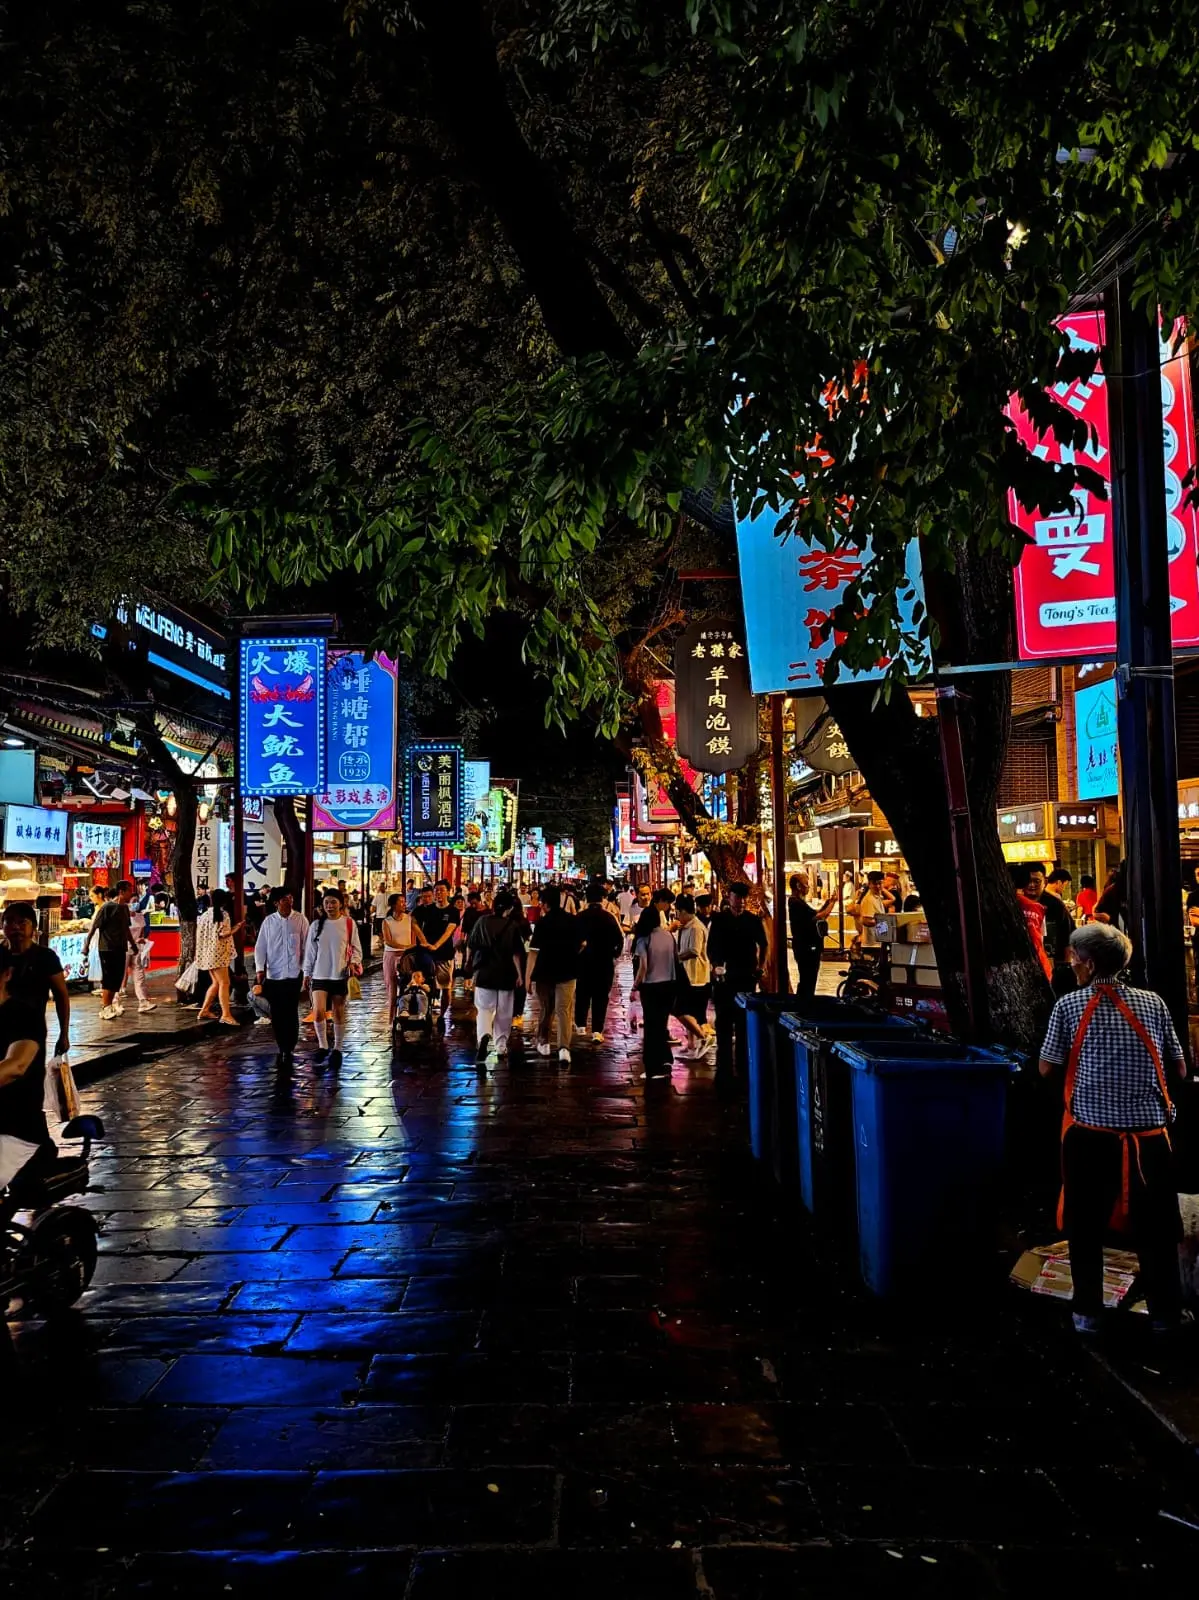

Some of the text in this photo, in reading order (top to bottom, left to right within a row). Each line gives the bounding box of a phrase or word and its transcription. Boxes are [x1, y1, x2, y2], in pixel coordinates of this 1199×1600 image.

[1044, 605, 1084, 622] Tong's
[1087, 604, 1109, 617] Tea
[249, 651, 316, 676] 火爆
[260, 703, 304, 788] 大鱿鱼
[342, 756, 368, 765] 传承
[343, 767, 367, 777] 1928
